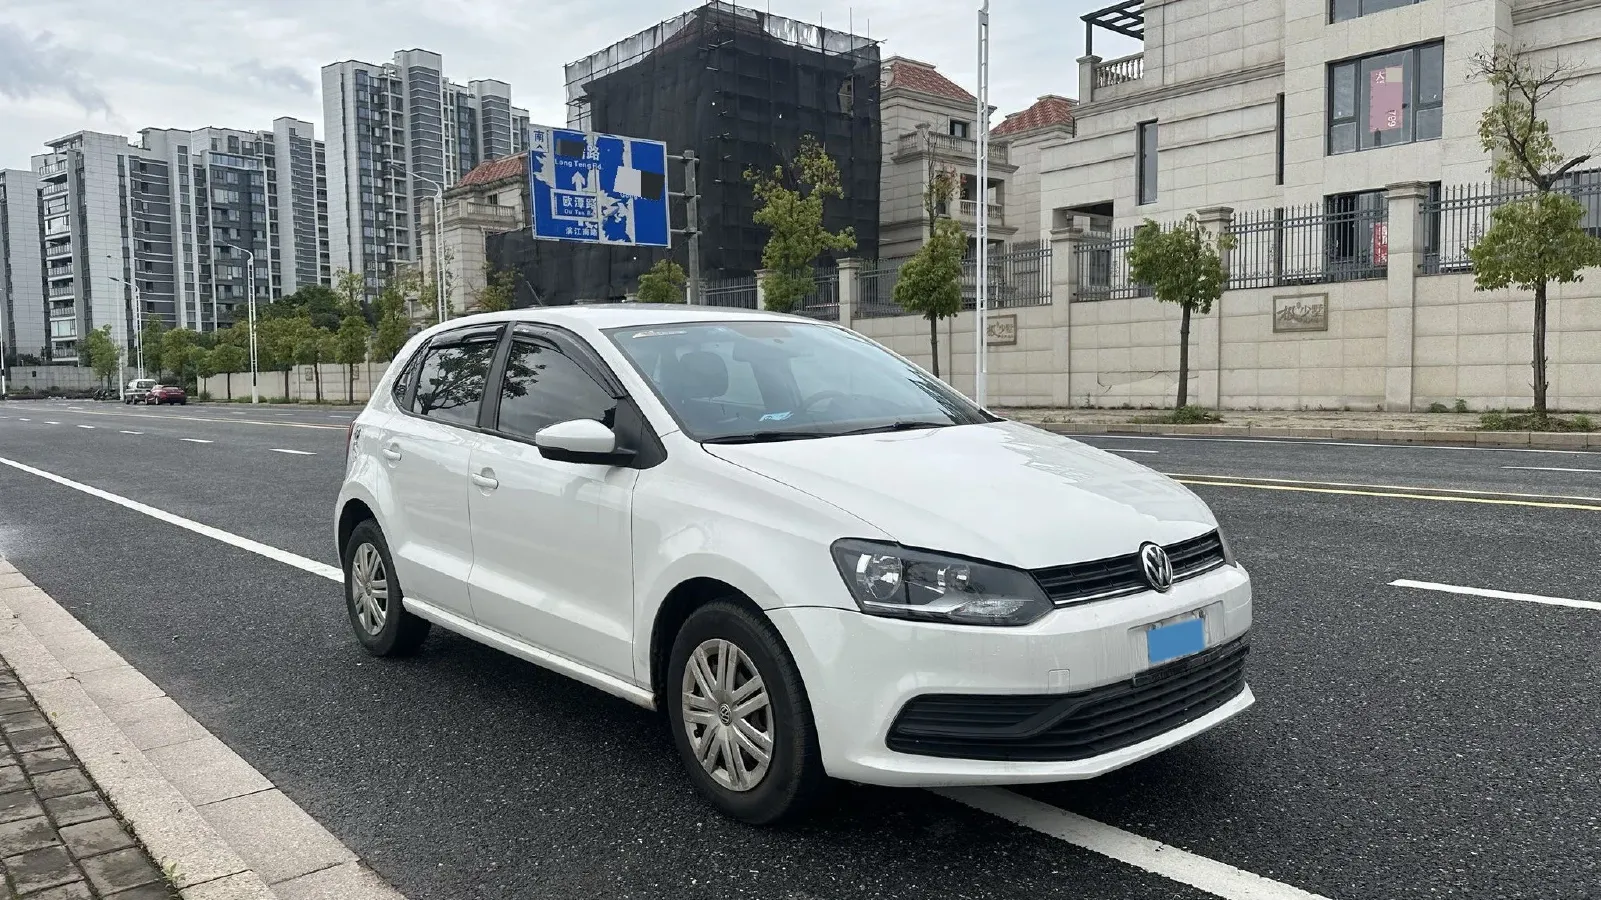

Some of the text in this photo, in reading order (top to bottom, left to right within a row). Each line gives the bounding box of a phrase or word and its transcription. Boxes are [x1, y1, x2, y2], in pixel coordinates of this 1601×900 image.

[533, 130, 545, 142] 南
[554, 159, 573, 168] Long
[573, 160, 592, 170] Teng
